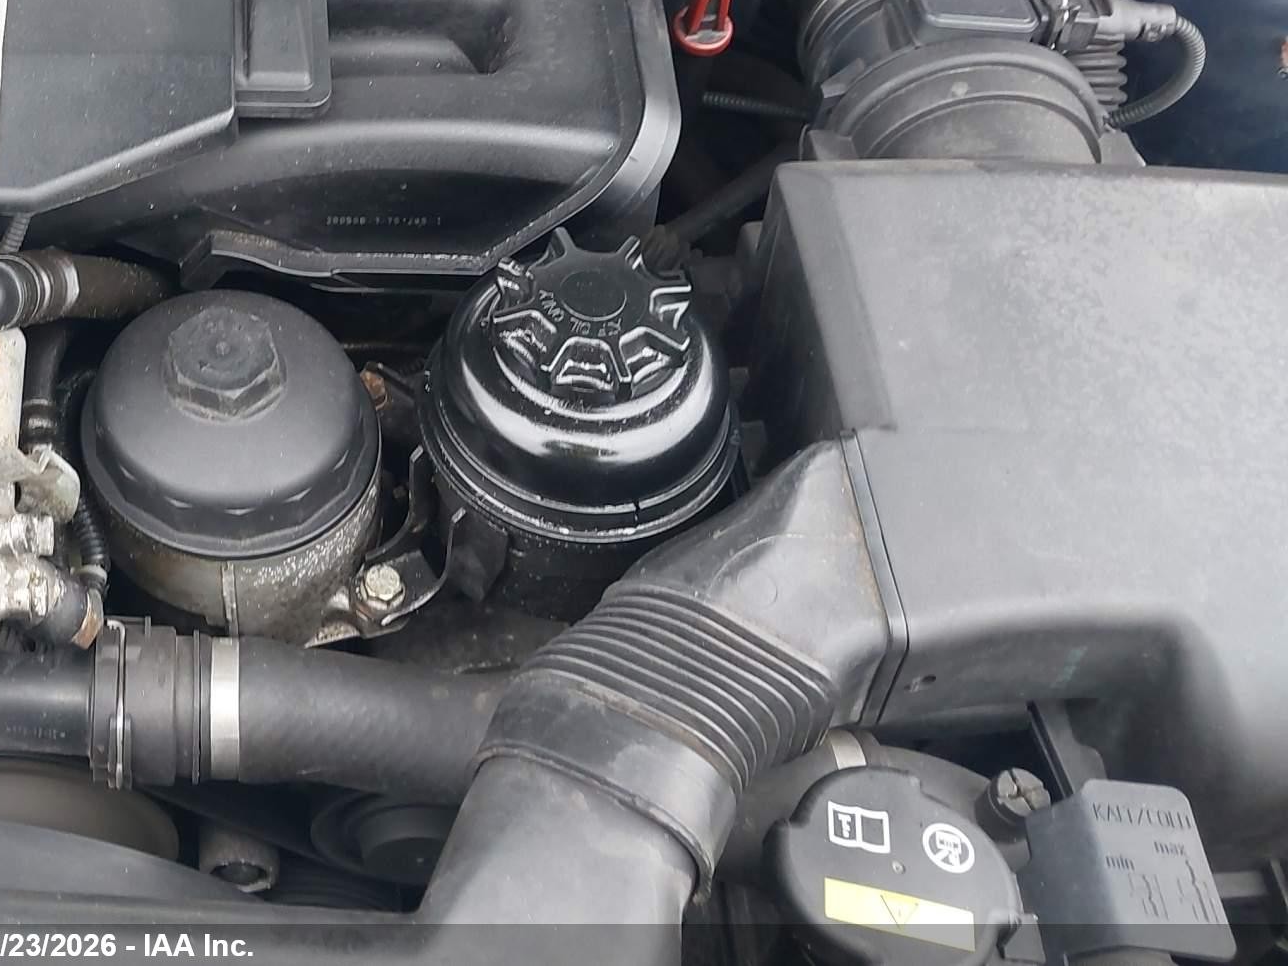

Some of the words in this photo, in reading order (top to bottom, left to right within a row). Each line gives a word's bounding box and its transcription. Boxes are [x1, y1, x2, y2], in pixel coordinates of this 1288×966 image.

[569, 317, 591, 335] OIL
[1153, 840, 1186, 857] max
[1105, 854, 1136, 872] min
